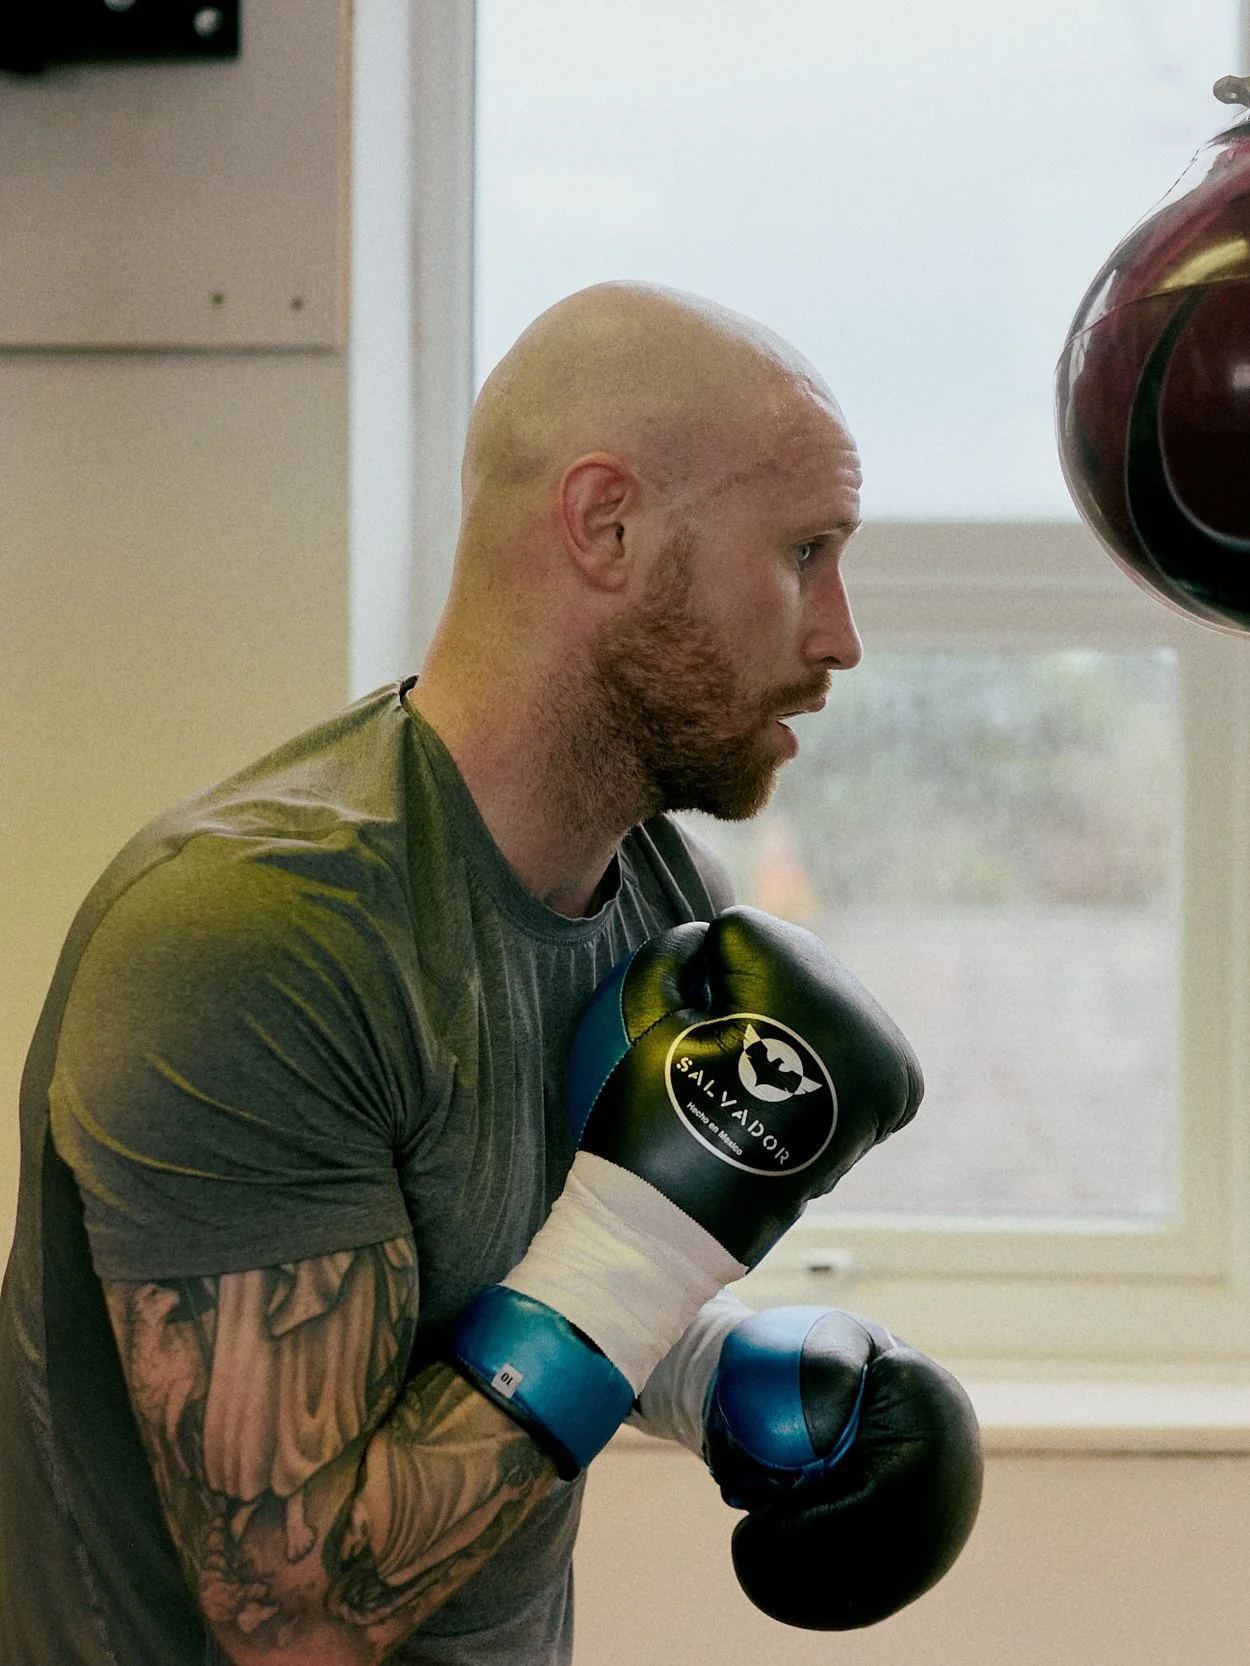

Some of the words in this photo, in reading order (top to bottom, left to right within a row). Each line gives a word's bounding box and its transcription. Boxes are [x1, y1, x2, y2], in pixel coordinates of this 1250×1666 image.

[676, 1057, 789, 1165] SALVADOR
[687, 1102, 709, 1124] Hecho
[708, 1122, 719, 1134] en
[718, 1131, 743, 1156] Mexico
